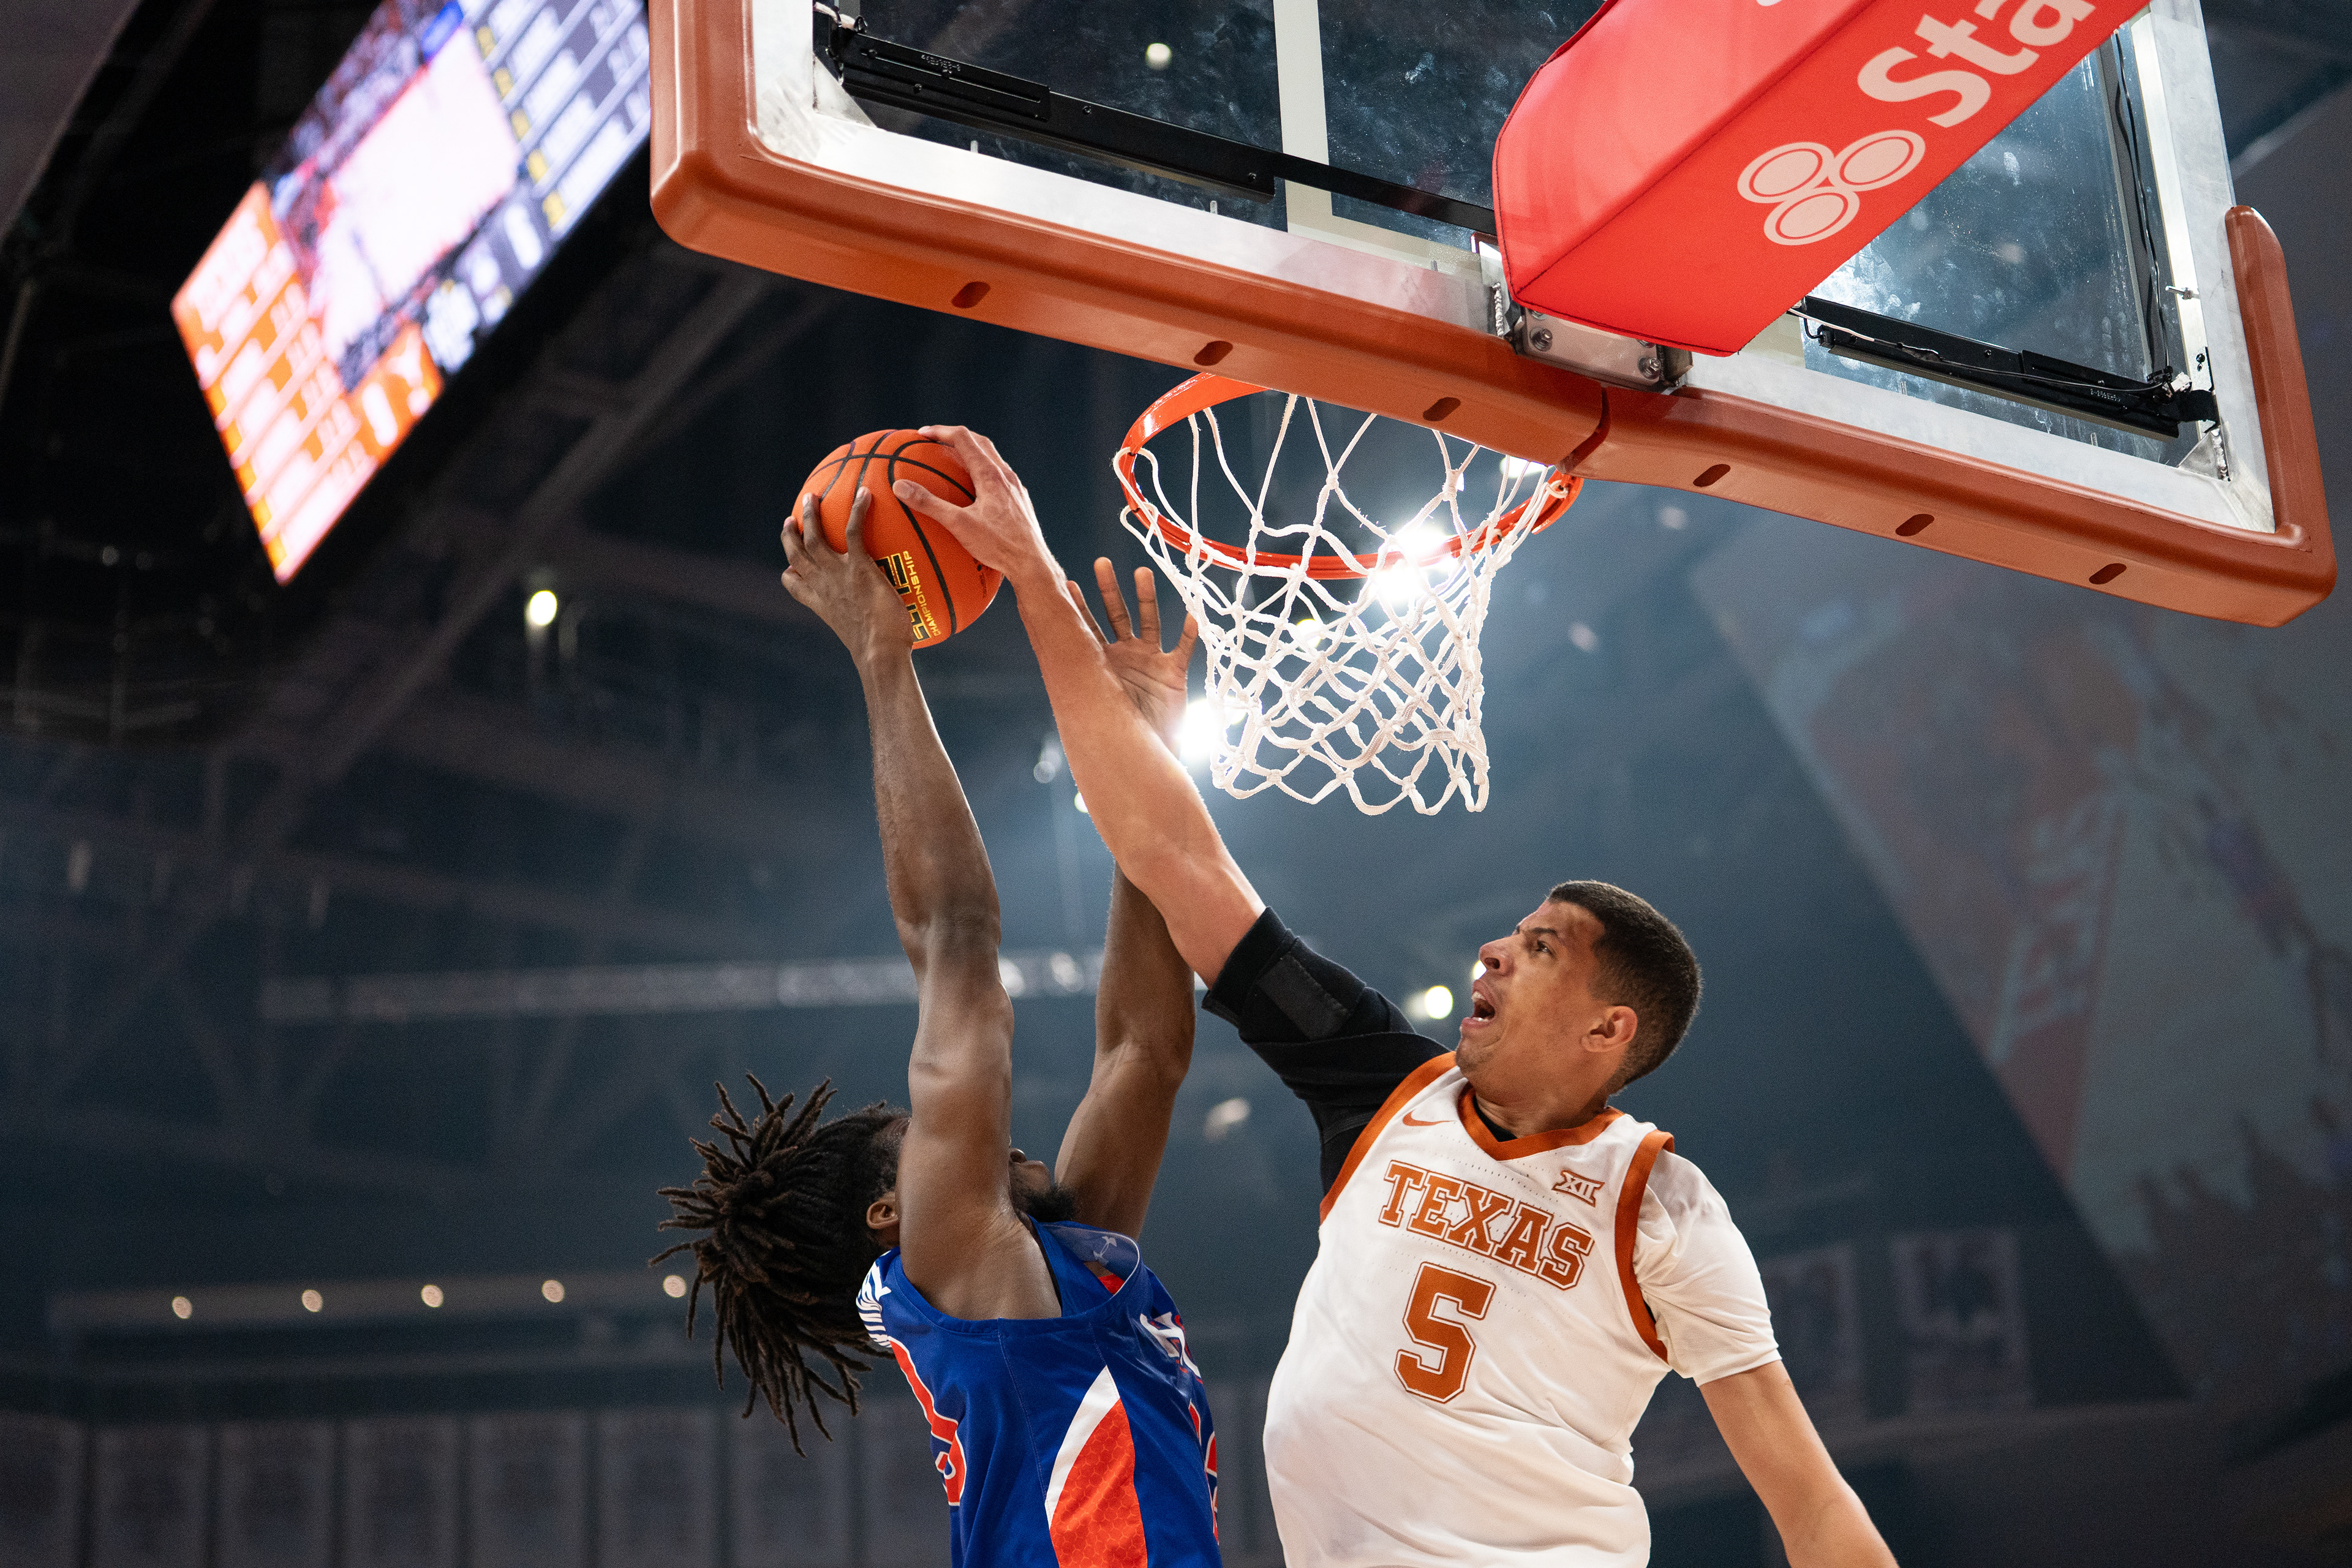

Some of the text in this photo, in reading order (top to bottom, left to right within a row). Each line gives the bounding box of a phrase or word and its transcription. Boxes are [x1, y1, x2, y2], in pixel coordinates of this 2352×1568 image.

[903, 551, 941, 636] CHAMPIONSHIP
[1378, 1159, 1595, 1291] TEXAS
[1552, 1170, 1604, 1207] XII
[1393, 1261, 1497, 1404] 5
